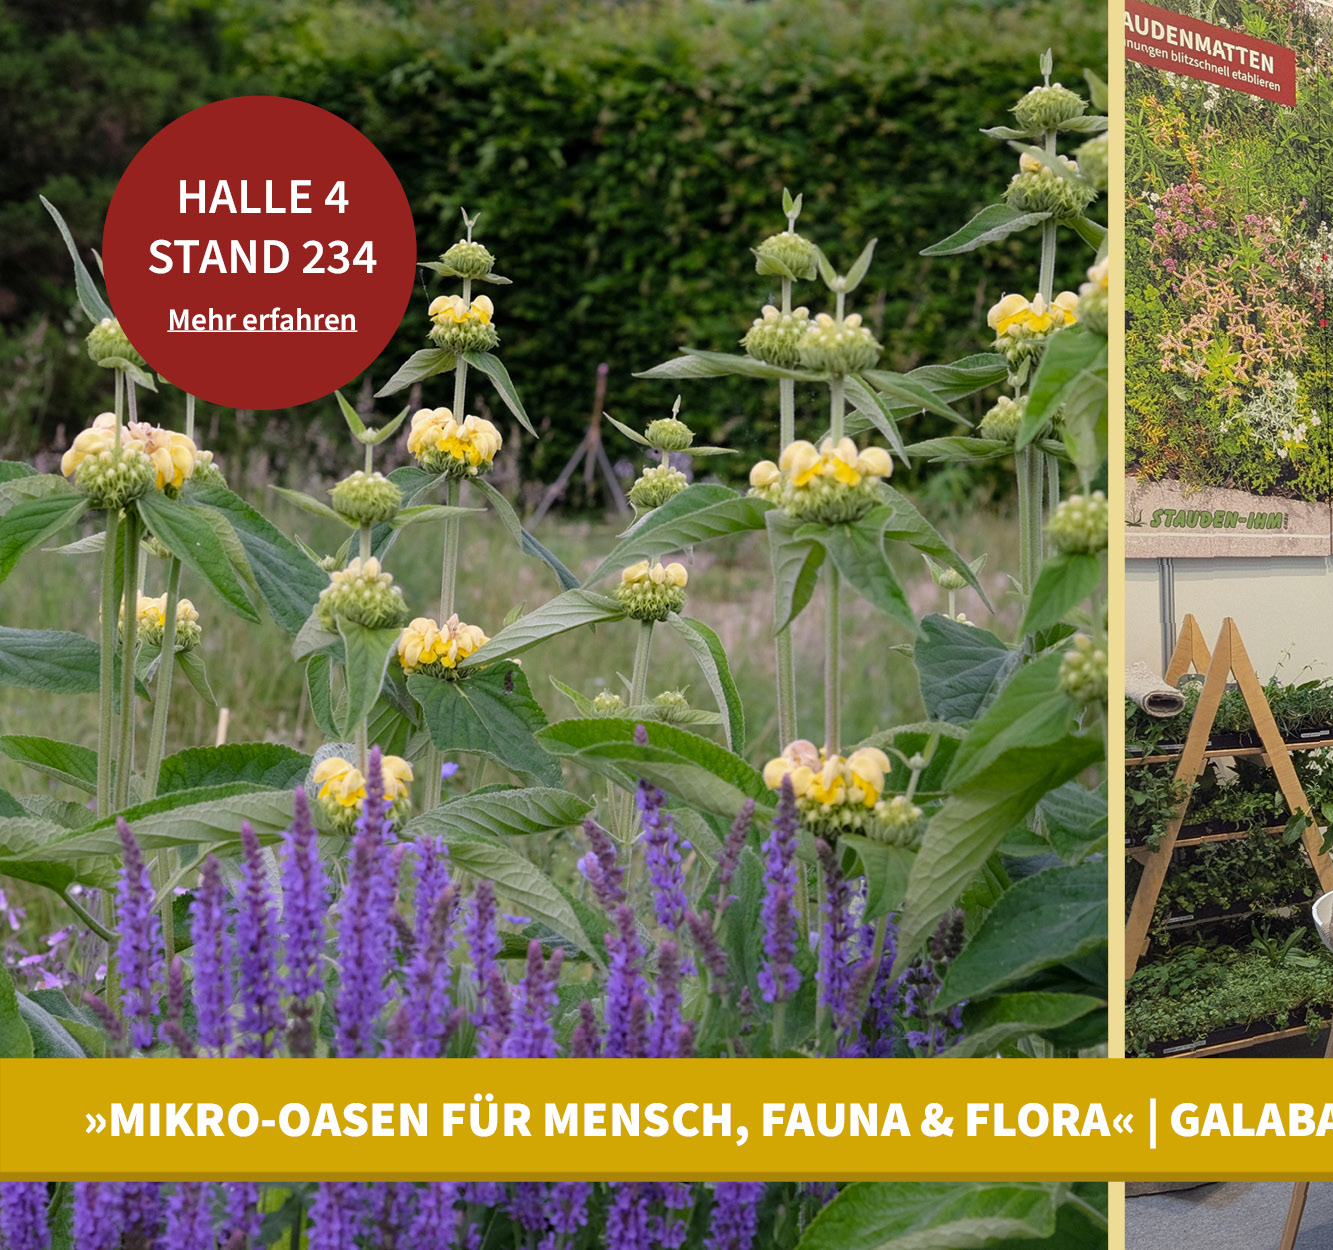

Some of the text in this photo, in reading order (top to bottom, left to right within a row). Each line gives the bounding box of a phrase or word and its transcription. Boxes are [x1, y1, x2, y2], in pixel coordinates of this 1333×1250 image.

[1125, 11, 1275, 74] AUDENMATTEN
[1171, 50, 1230, 78] blitzschnell
[1232, 70, 1281, 92] etablieren
[1150, 508, 1283, 529] STAUDEN-IHM
